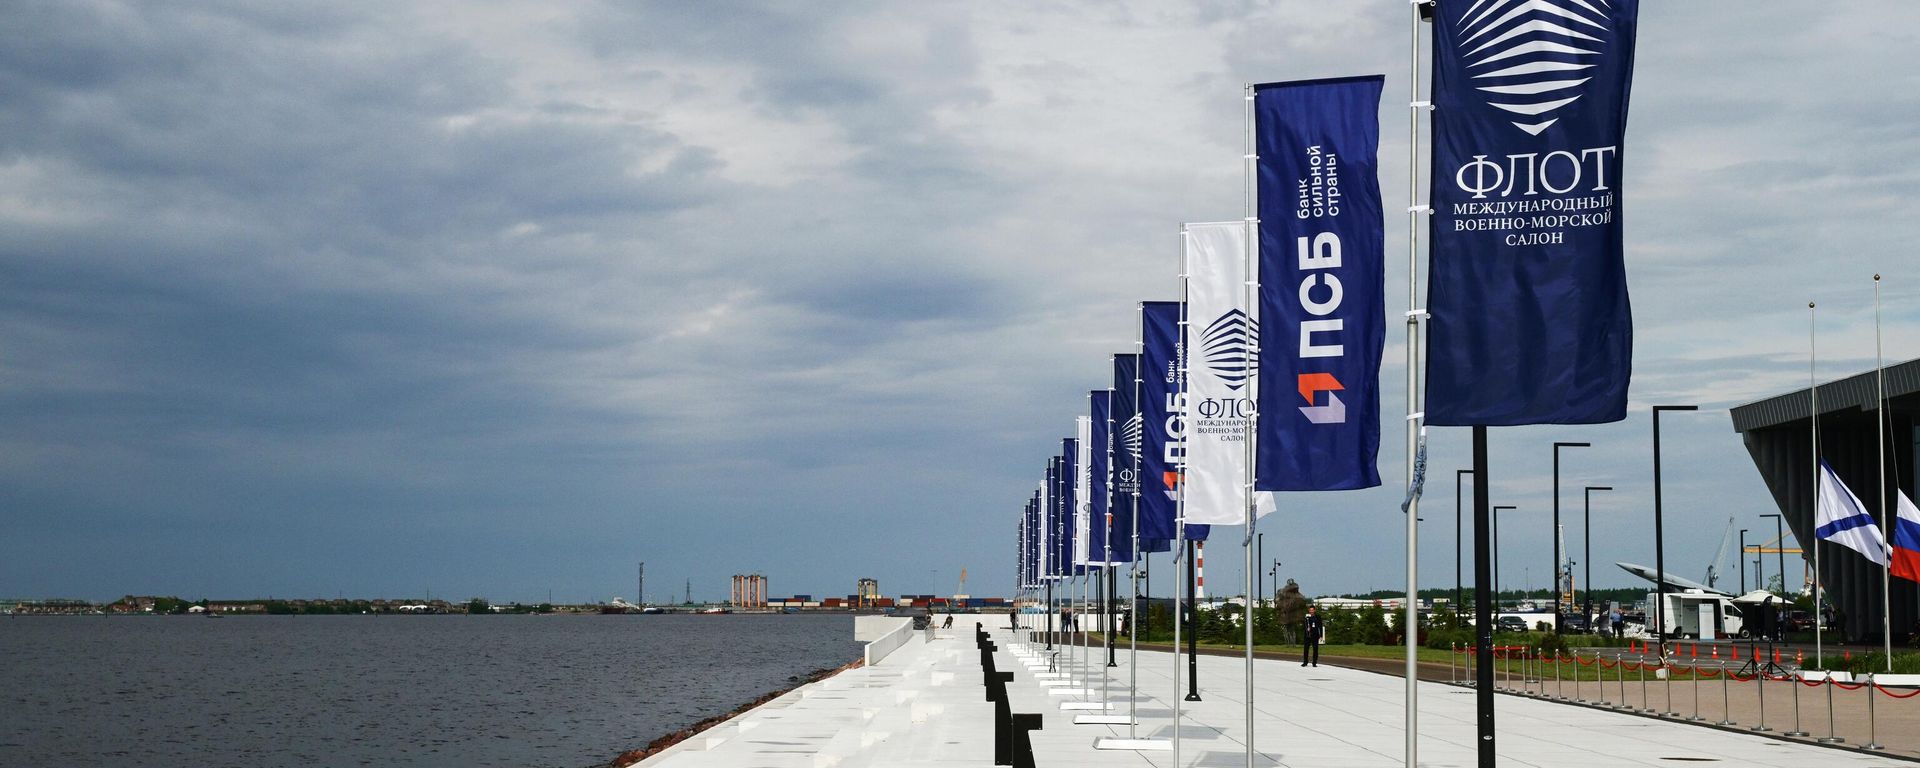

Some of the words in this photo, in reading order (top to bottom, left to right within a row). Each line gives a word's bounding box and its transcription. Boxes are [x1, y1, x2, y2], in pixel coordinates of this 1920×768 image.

[1306, 145, 1322, 218] сильной
[1326, 153, 1341, 217] страны
[1456, 145, 1616, 199] ФЛОТ
[1297, 179, 1310, 219] банк
[1453, 193, 1613, 215] МЕЖДУНАРОДНЫЙ
[1455, 209, 1612, 231] ВОЕННО-МОРСКОЙ
[1505, 232, 1564, 246] САЛОН
[1297, 231, 1344, 359] ПСБ
[1166, 360, 1175, 383] банк
[1164, 392, 1187, 463] ПСБ
[1198, 398, 1256, 419] ФЛО
